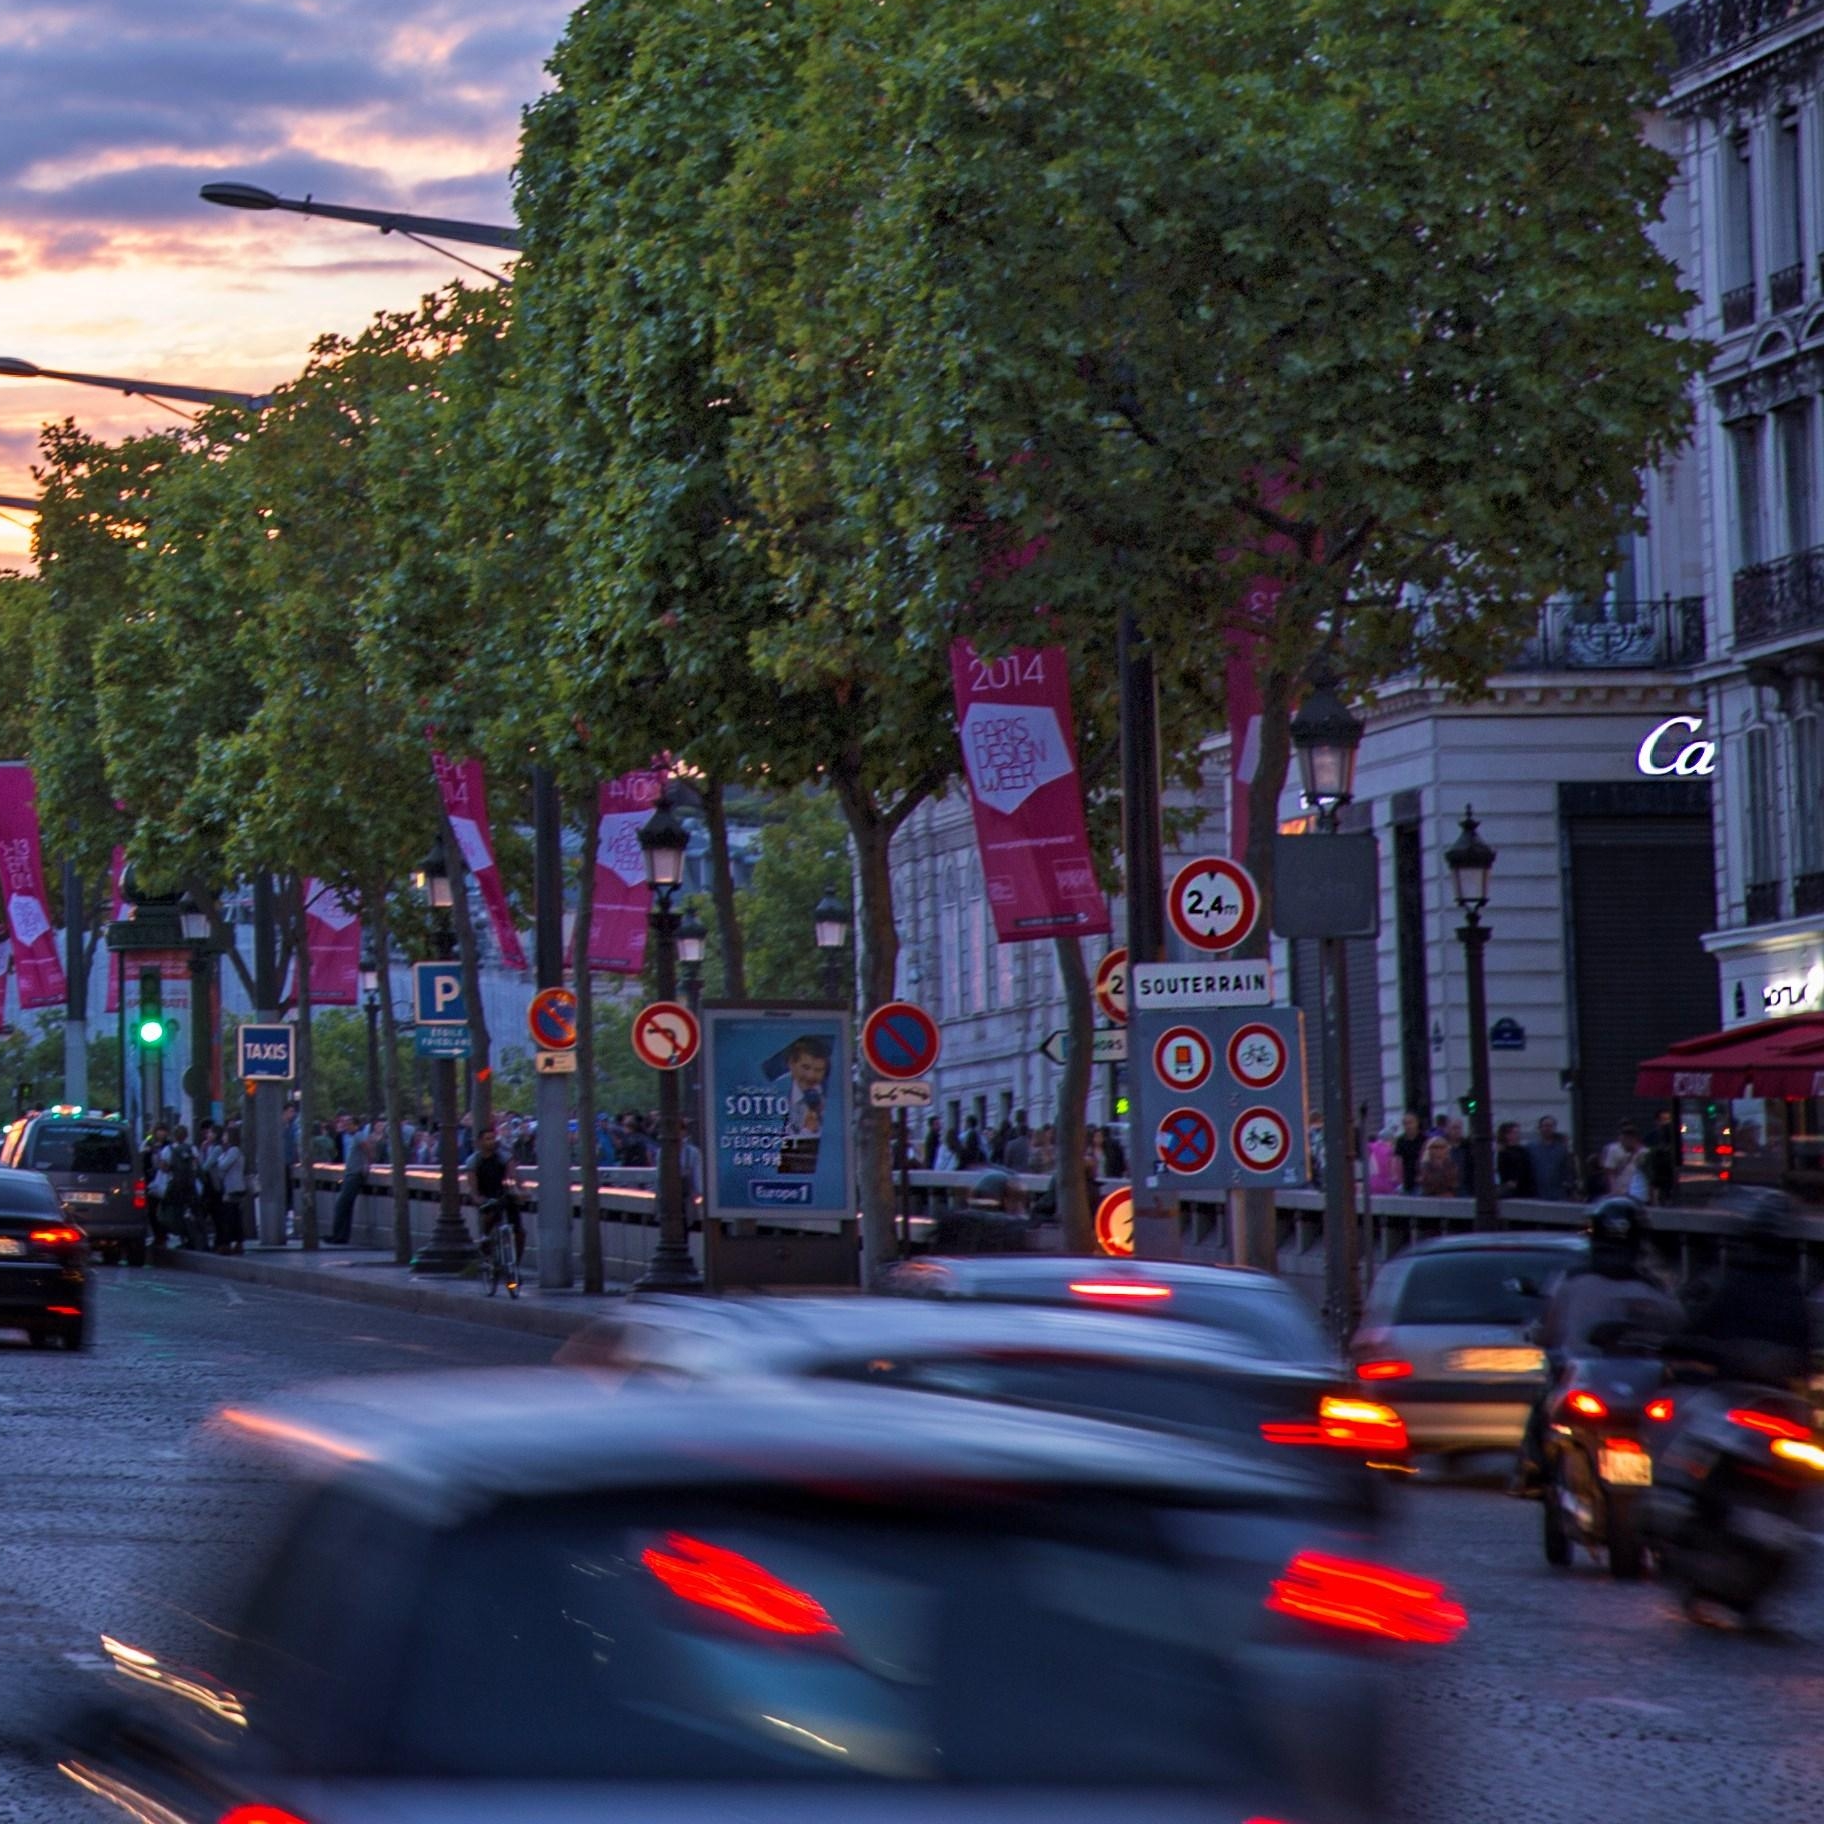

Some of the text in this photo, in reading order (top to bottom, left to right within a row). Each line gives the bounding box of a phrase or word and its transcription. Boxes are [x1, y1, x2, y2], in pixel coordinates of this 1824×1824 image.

[968, 654, 1045, 692] 2014
[970, 717, 1030, 746] PARIS
[1637, 715, 1716, 775] Ca
[975, 740, 1047, 770] DESIGN
[979, 764, 1037, 792] WEEK
[1187, 889, 1239, 919] 2,4m
[434, 975, 460, 1013] P
[1139, 973, 1266, 996] SOUTERRAIN
[245, 1043, 288, 1060] TAXIS
[725, 1096, 790, 1115] SOTTO
[720, 1135, 790, 1149] D'EUROPE
